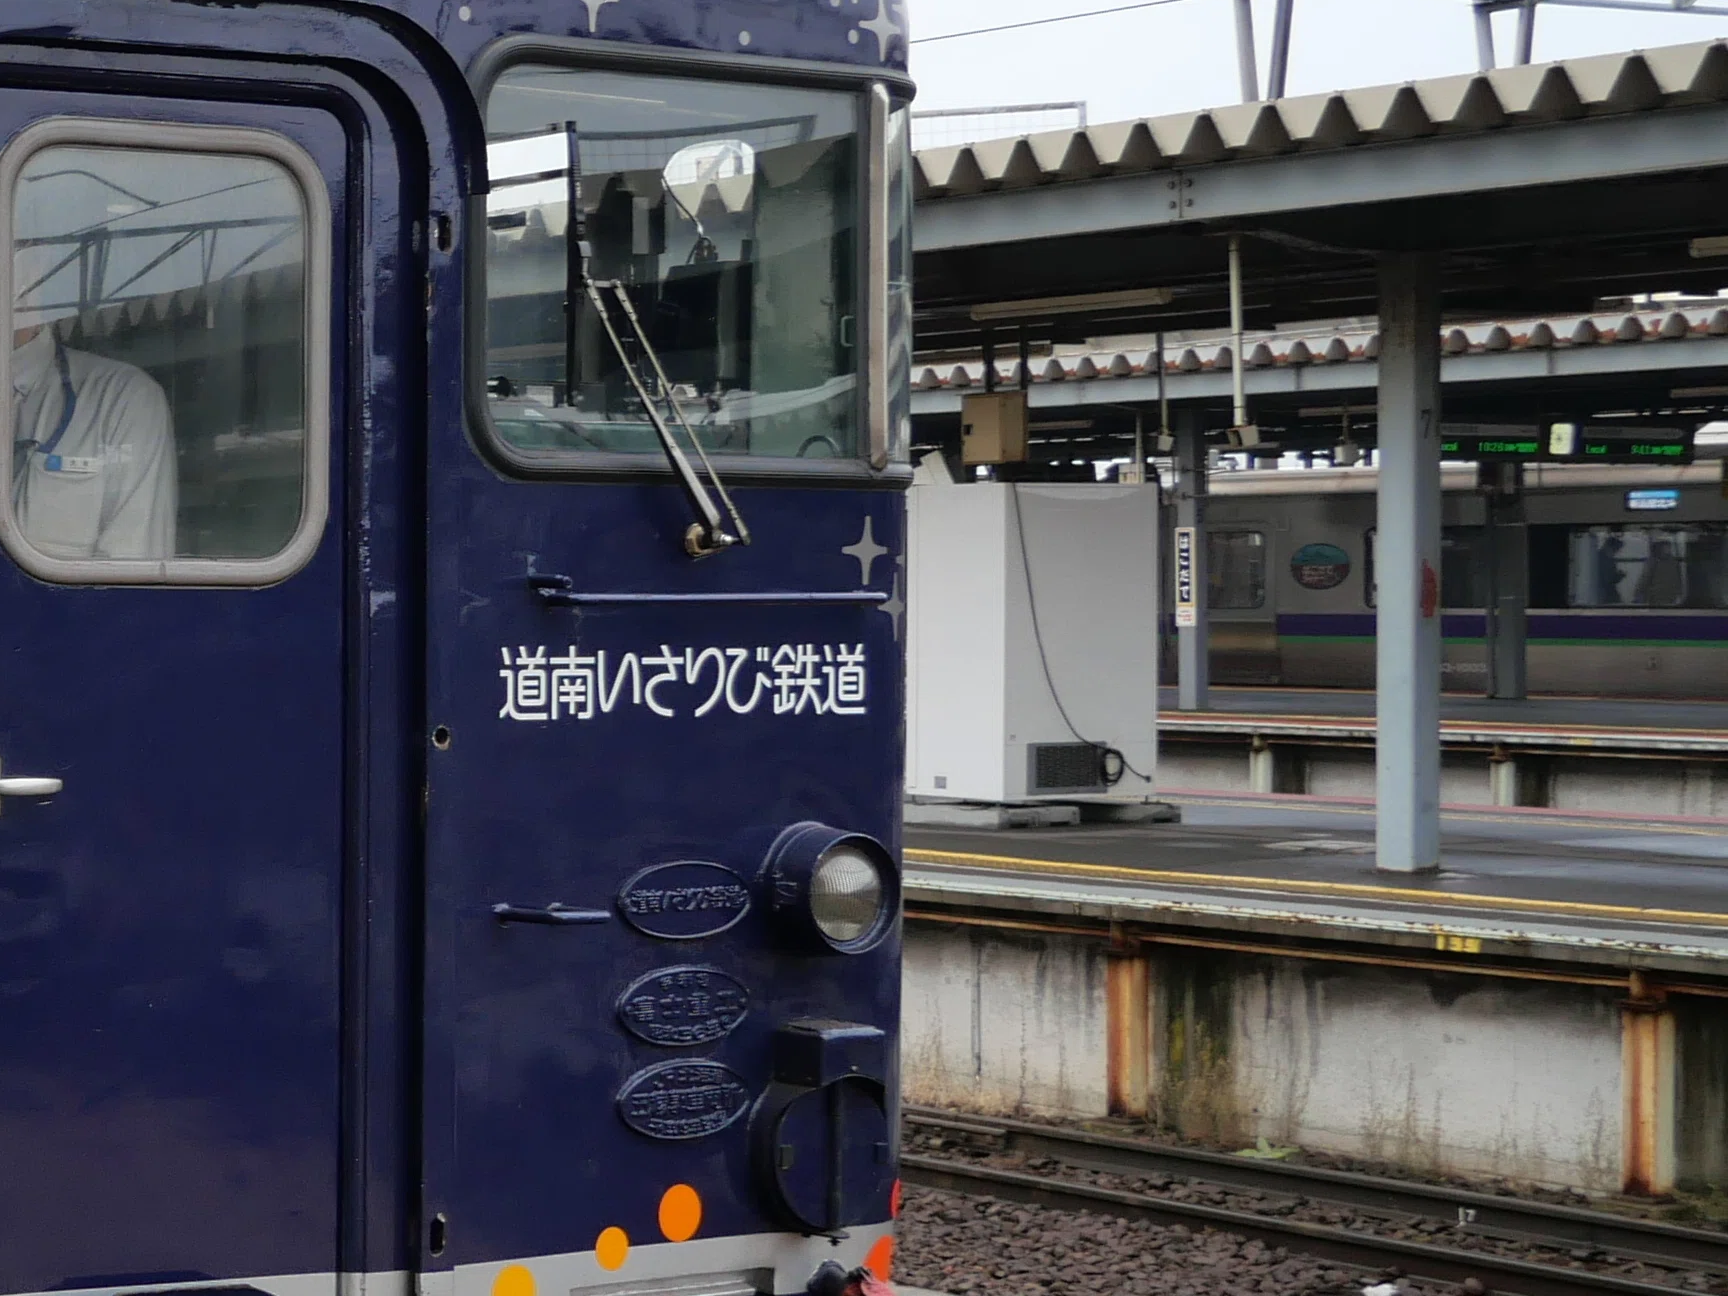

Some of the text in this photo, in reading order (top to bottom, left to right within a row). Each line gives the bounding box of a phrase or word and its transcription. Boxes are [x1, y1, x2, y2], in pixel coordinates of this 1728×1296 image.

[500, 644, 865, 720] 道南いさりび鉄道
